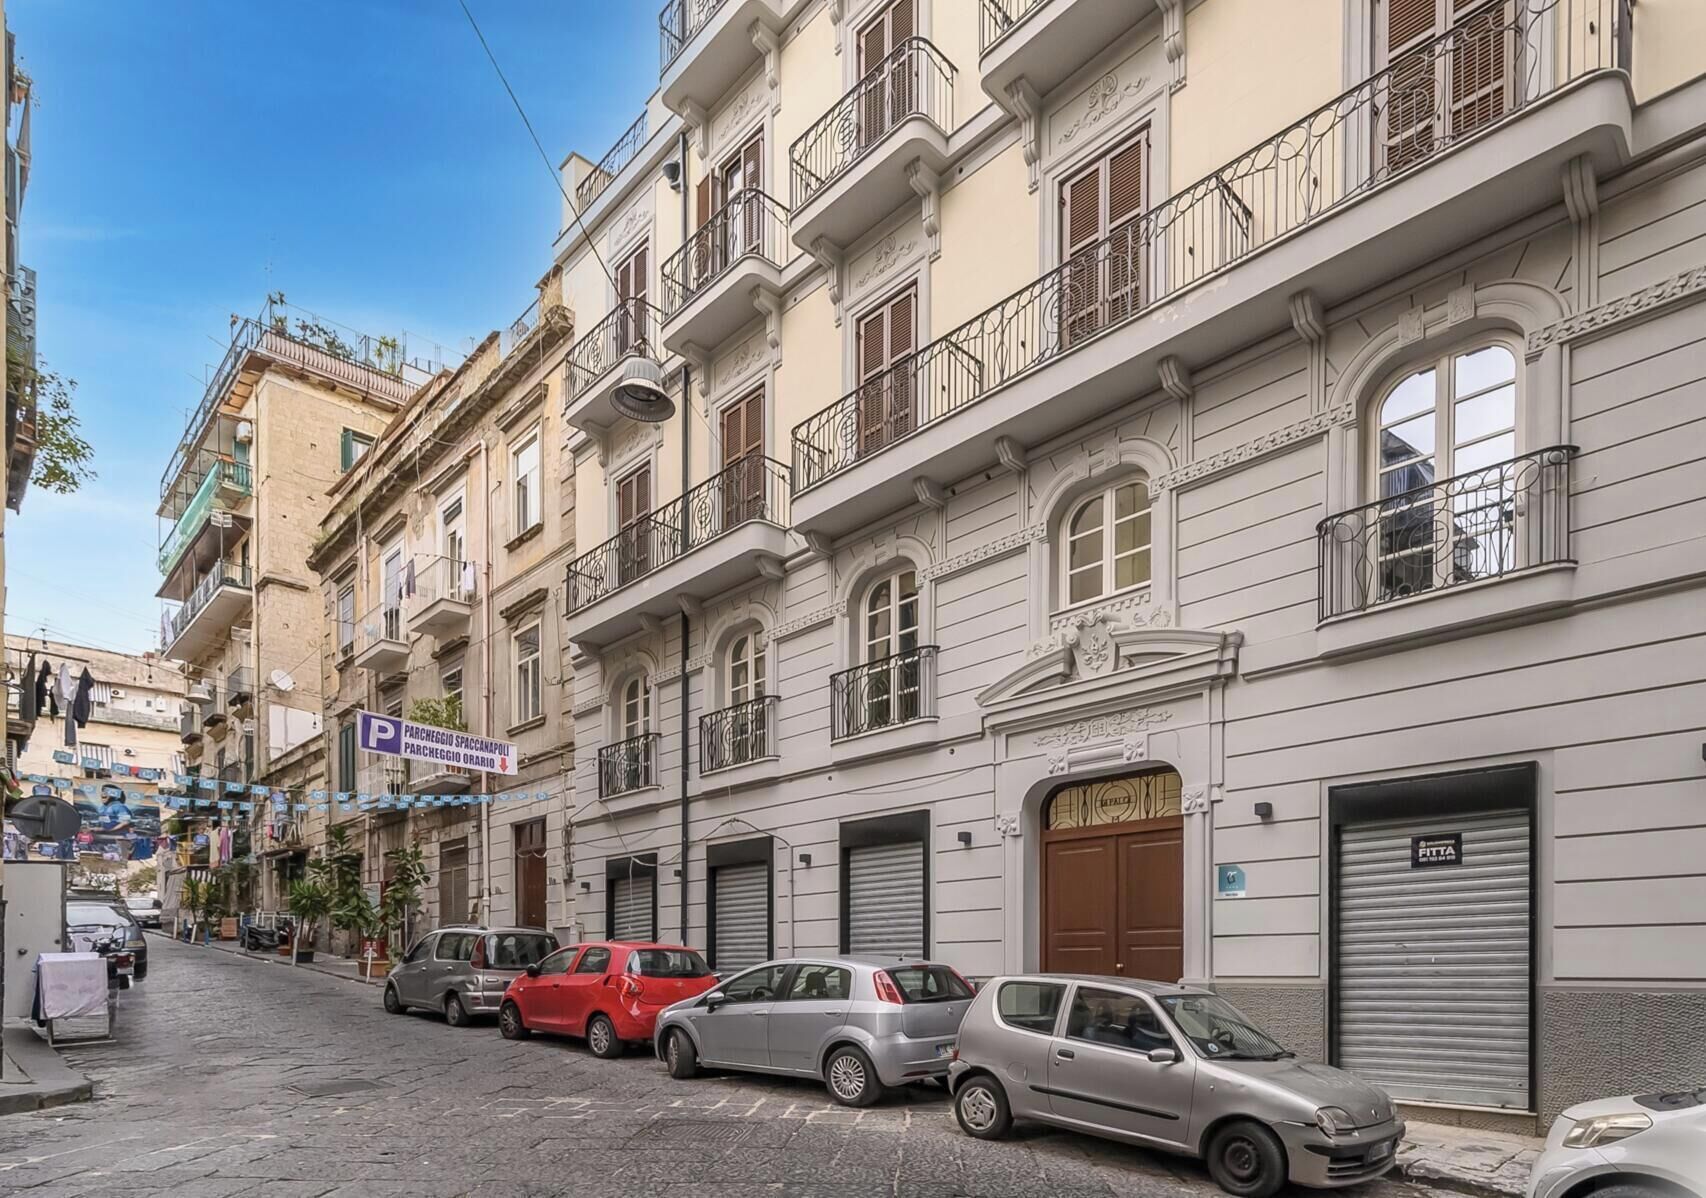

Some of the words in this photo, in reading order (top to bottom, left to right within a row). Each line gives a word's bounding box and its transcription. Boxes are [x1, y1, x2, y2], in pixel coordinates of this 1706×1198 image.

[369, 718, 395, 747] P
[404, 725, 453, 747] PARCHEGGIO
[455, 734, 509, 757] SPACCANAPOLI
[404, 742, 461, 762] PARCHEGGIO
[462, 753, 495, 769] ORARIO
[1419, 846, 1455, 857] FITTA
